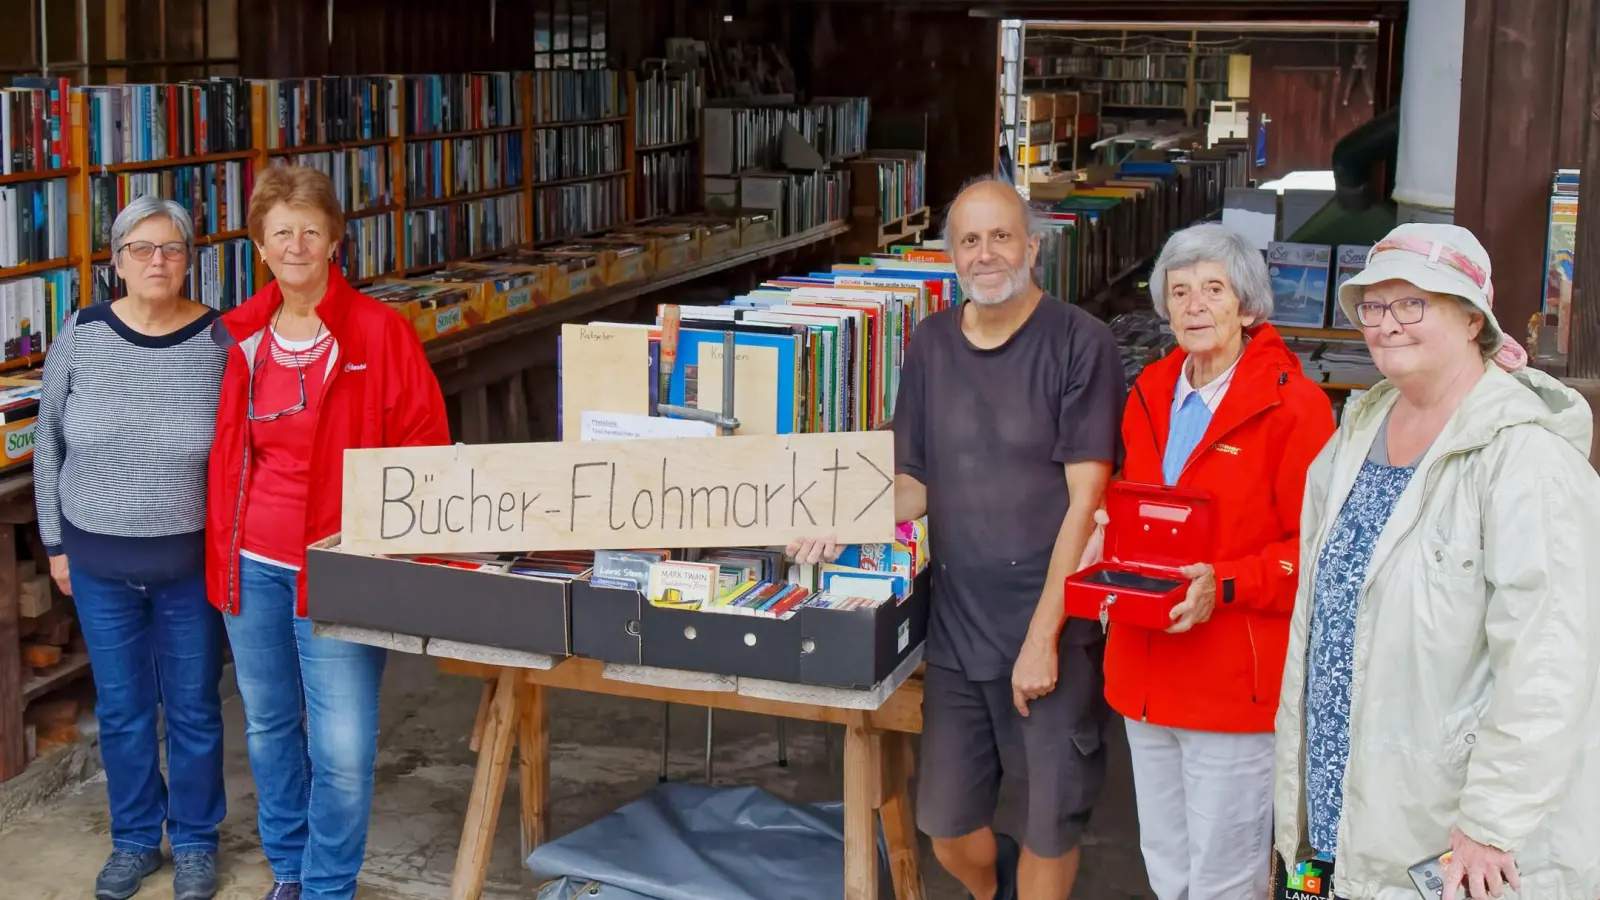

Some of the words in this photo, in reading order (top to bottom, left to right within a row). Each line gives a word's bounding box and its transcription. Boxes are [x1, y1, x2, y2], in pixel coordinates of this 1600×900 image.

[580, 328, 615, 341] Ratgeber
[711, 345, 749, 361] Koen
[661, 570, 682, 579] MARK
[684, 571, 708, 581] TWAIN
